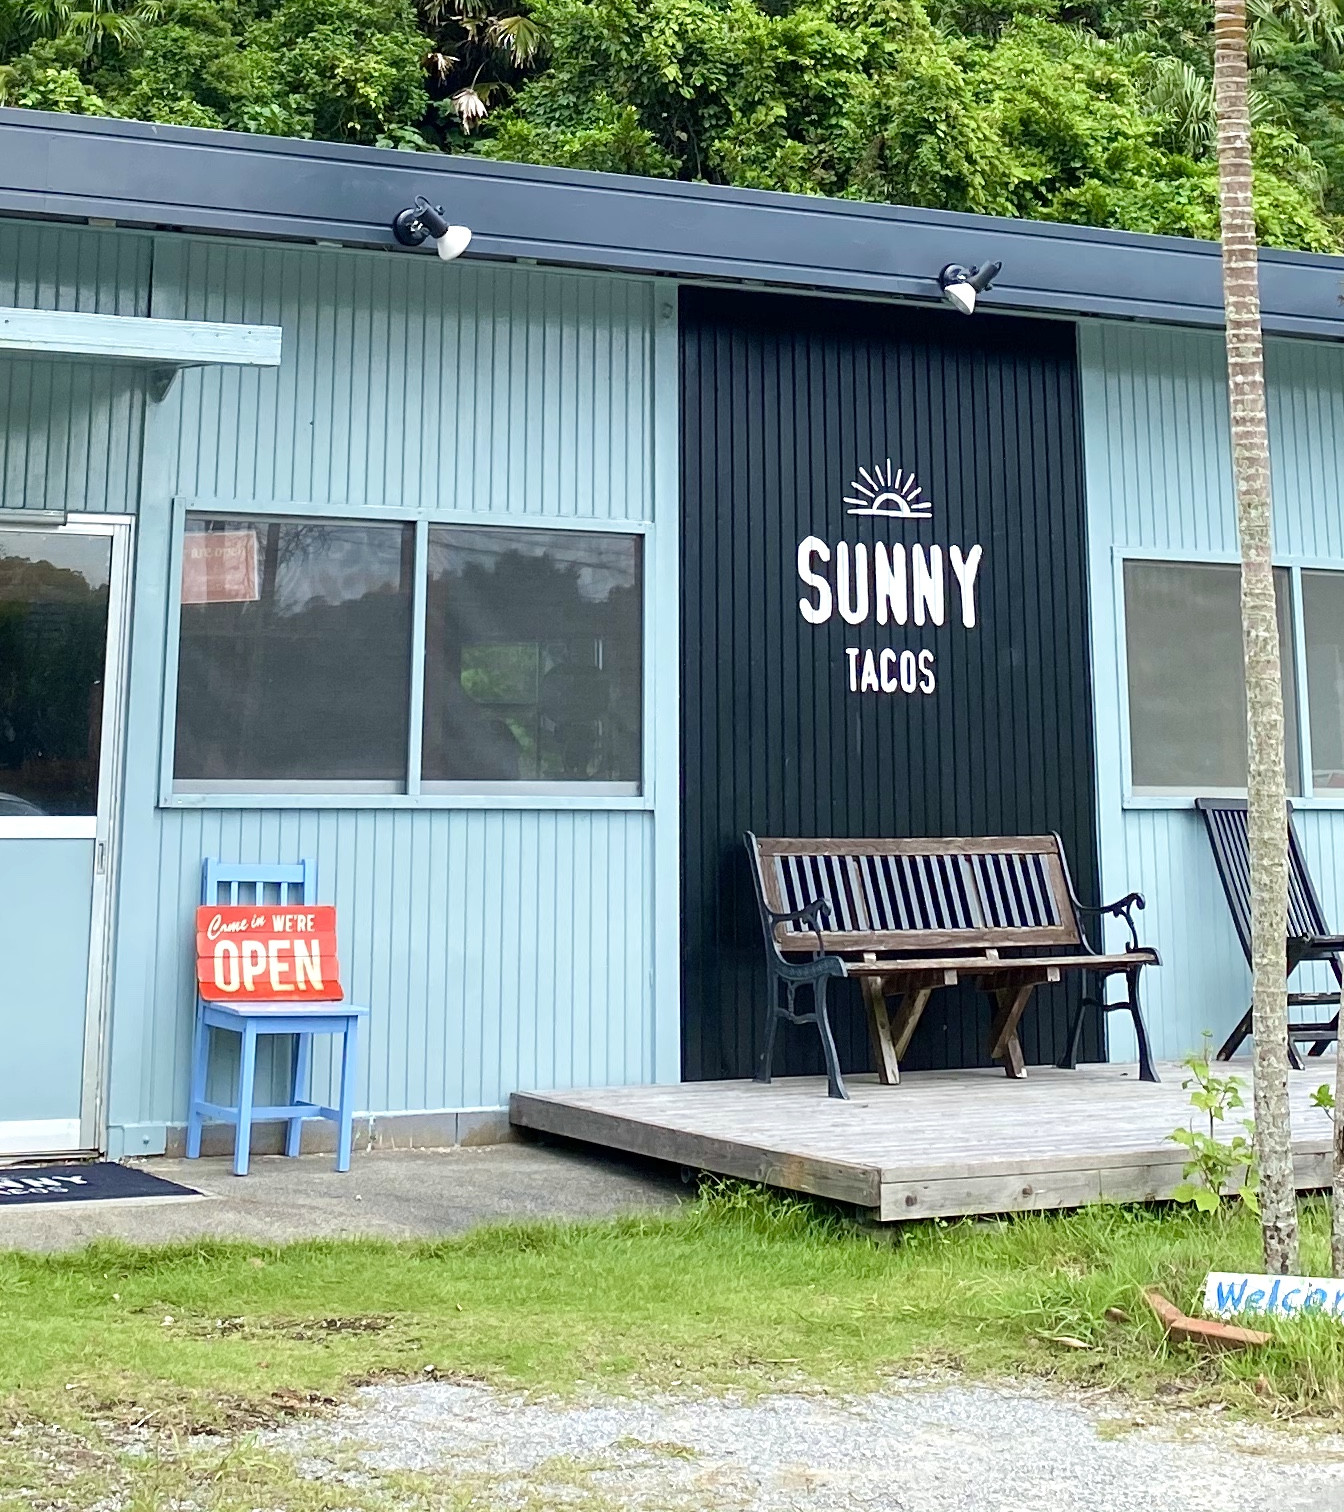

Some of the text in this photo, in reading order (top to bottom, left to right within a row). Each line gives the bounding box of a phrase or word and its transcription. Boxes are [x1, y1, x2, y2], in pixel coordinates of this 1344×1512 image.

[797, 535, 982, 628] SUNNY
[845, 647, 936, 694] TACOS
[207, 913, 316, 941] Come in WE'RE
[213, 939, 325, 993] OPEN
